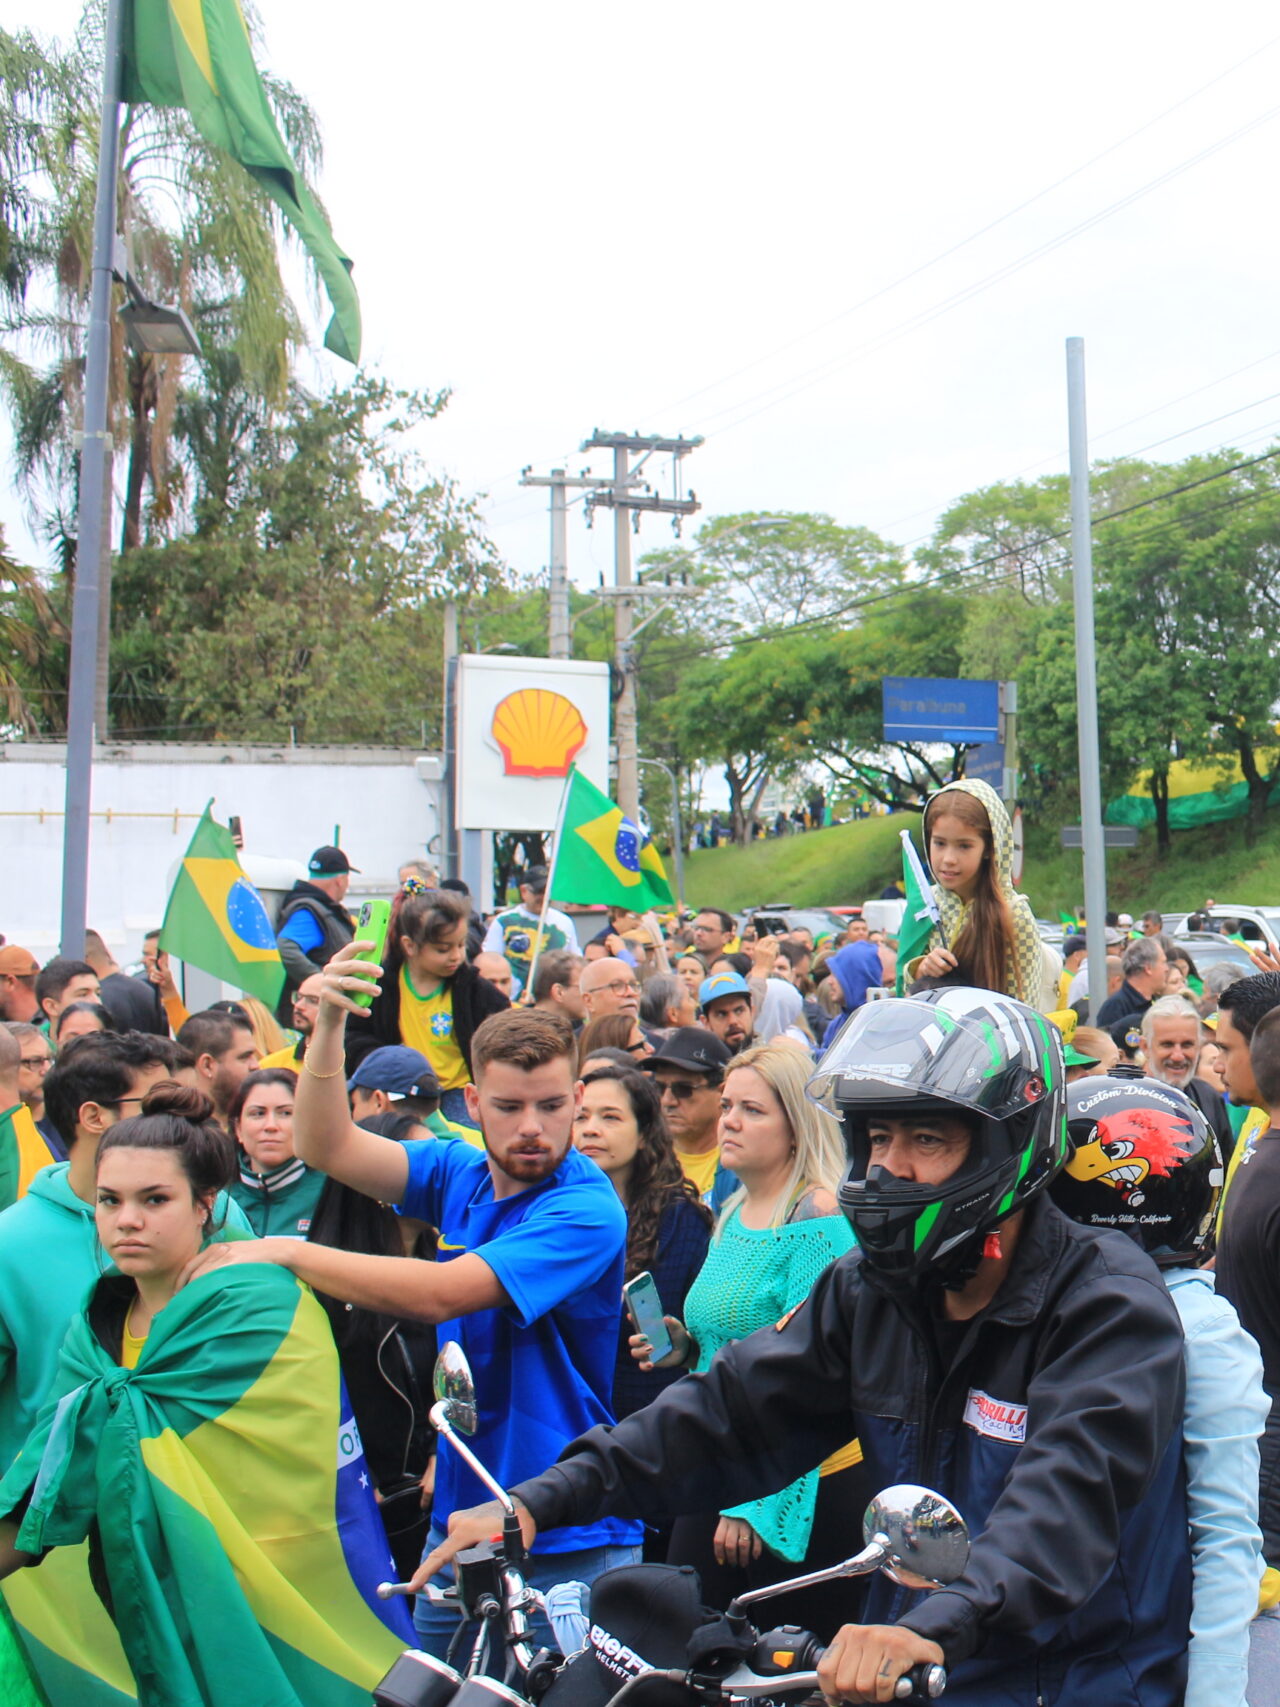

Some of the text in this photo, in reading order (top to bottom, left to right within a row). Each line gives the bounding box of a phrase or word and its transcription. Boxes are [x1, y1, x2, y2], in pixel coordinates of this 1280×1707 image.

[1077, 1085, 1179, 1113] Custom Division
[1091, 1213, 1118, 1225] Beverly
